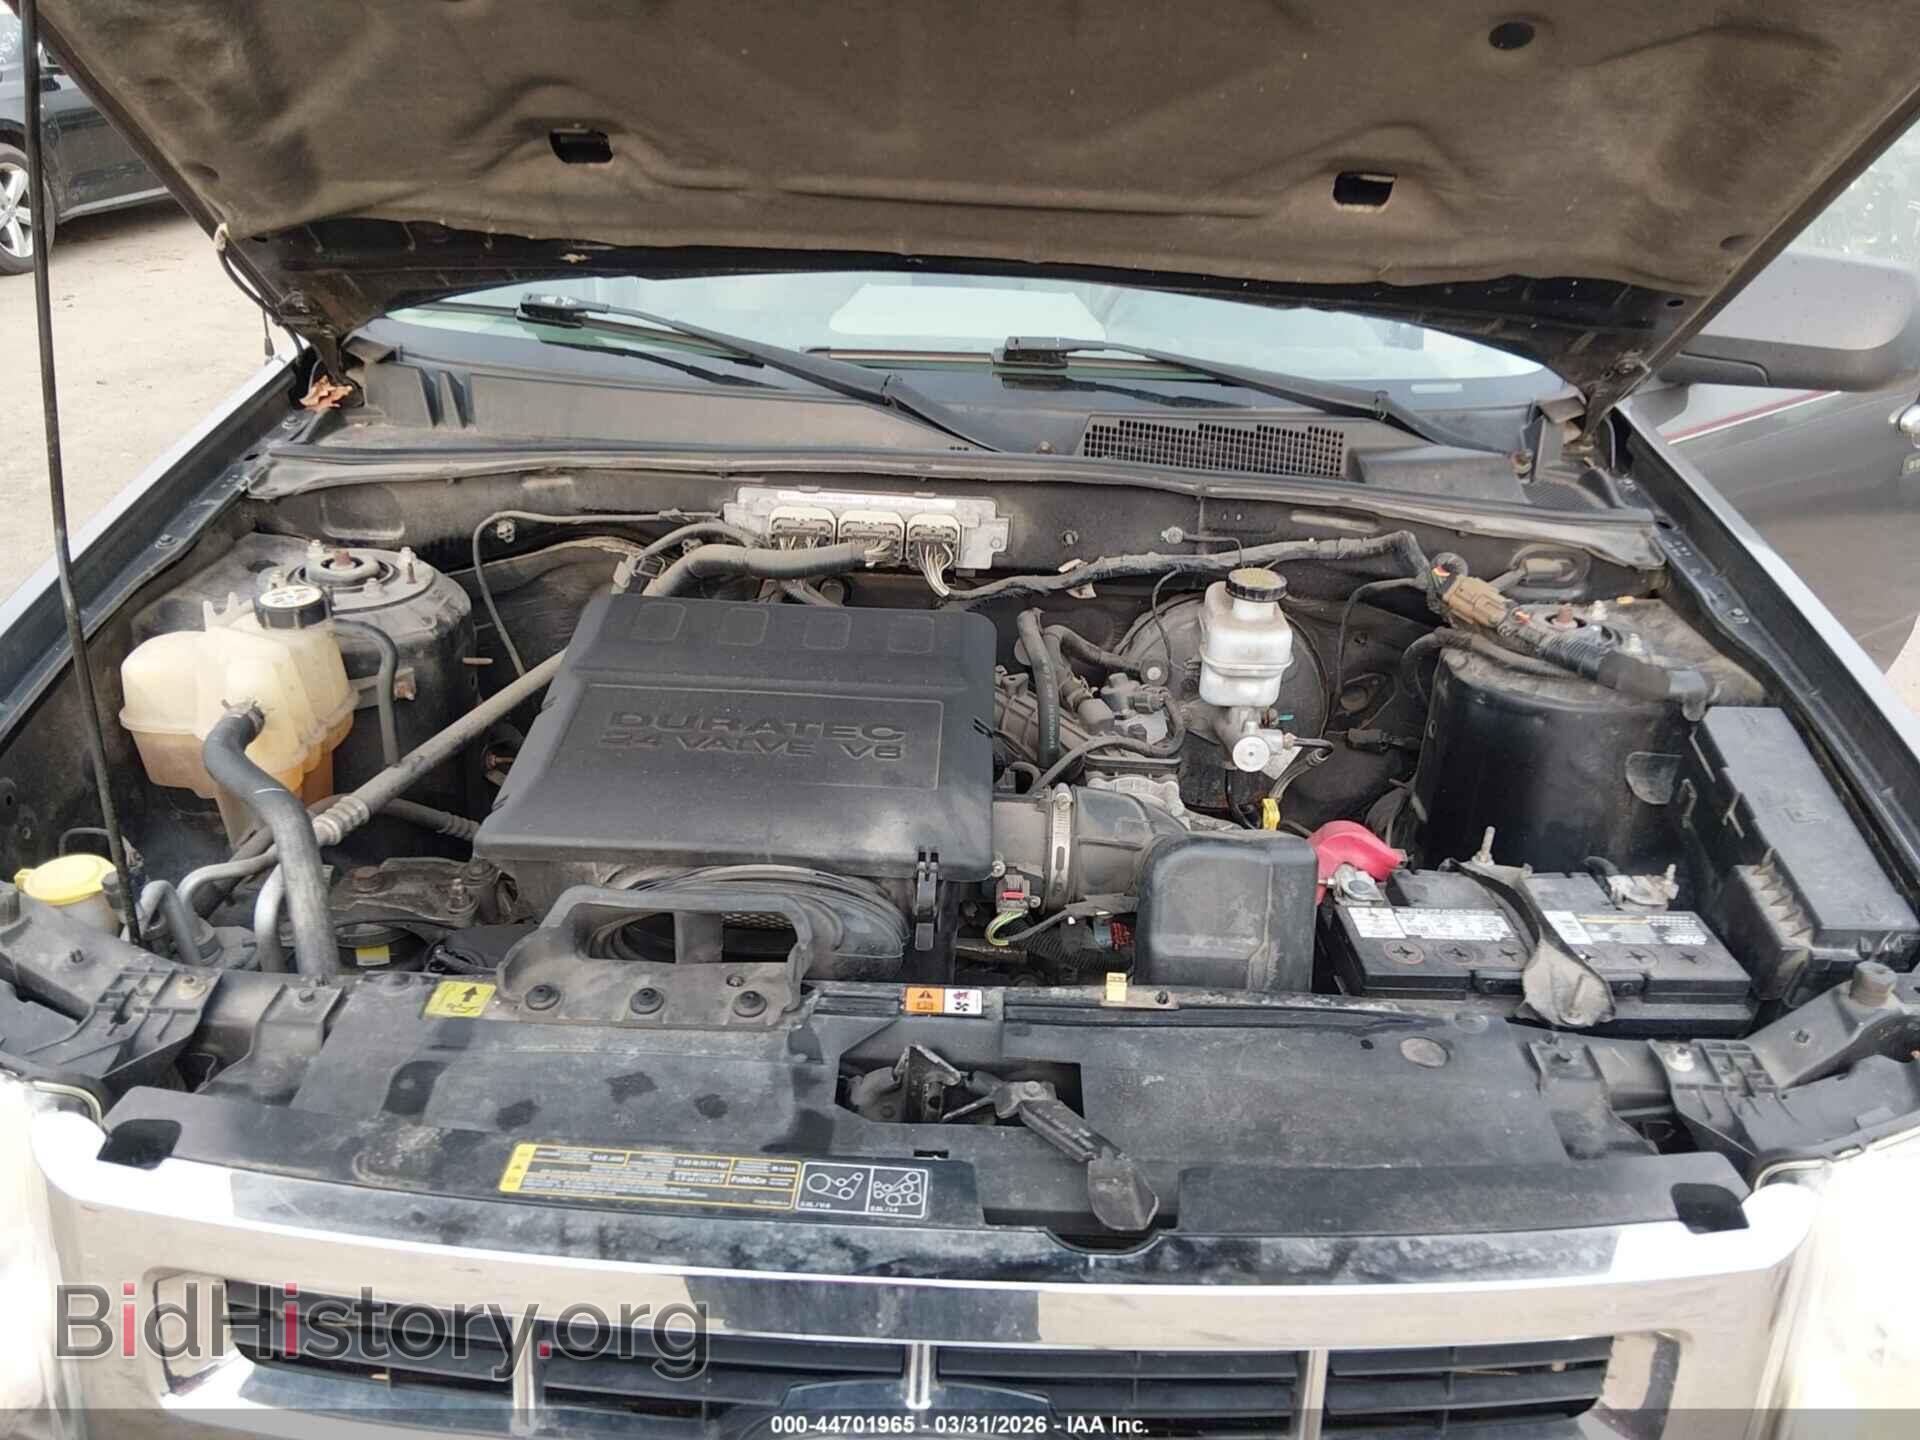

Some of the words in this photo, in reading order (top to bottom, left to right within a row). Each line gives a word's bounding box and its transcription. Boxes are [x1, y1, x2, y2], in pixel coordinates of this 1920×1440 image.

[610, 711, 906, 743] DURATEC
[601, 734, 658, 752] 24
[675, 735, 816, 758] VALVE
[838, 743, 905, 762] V6
